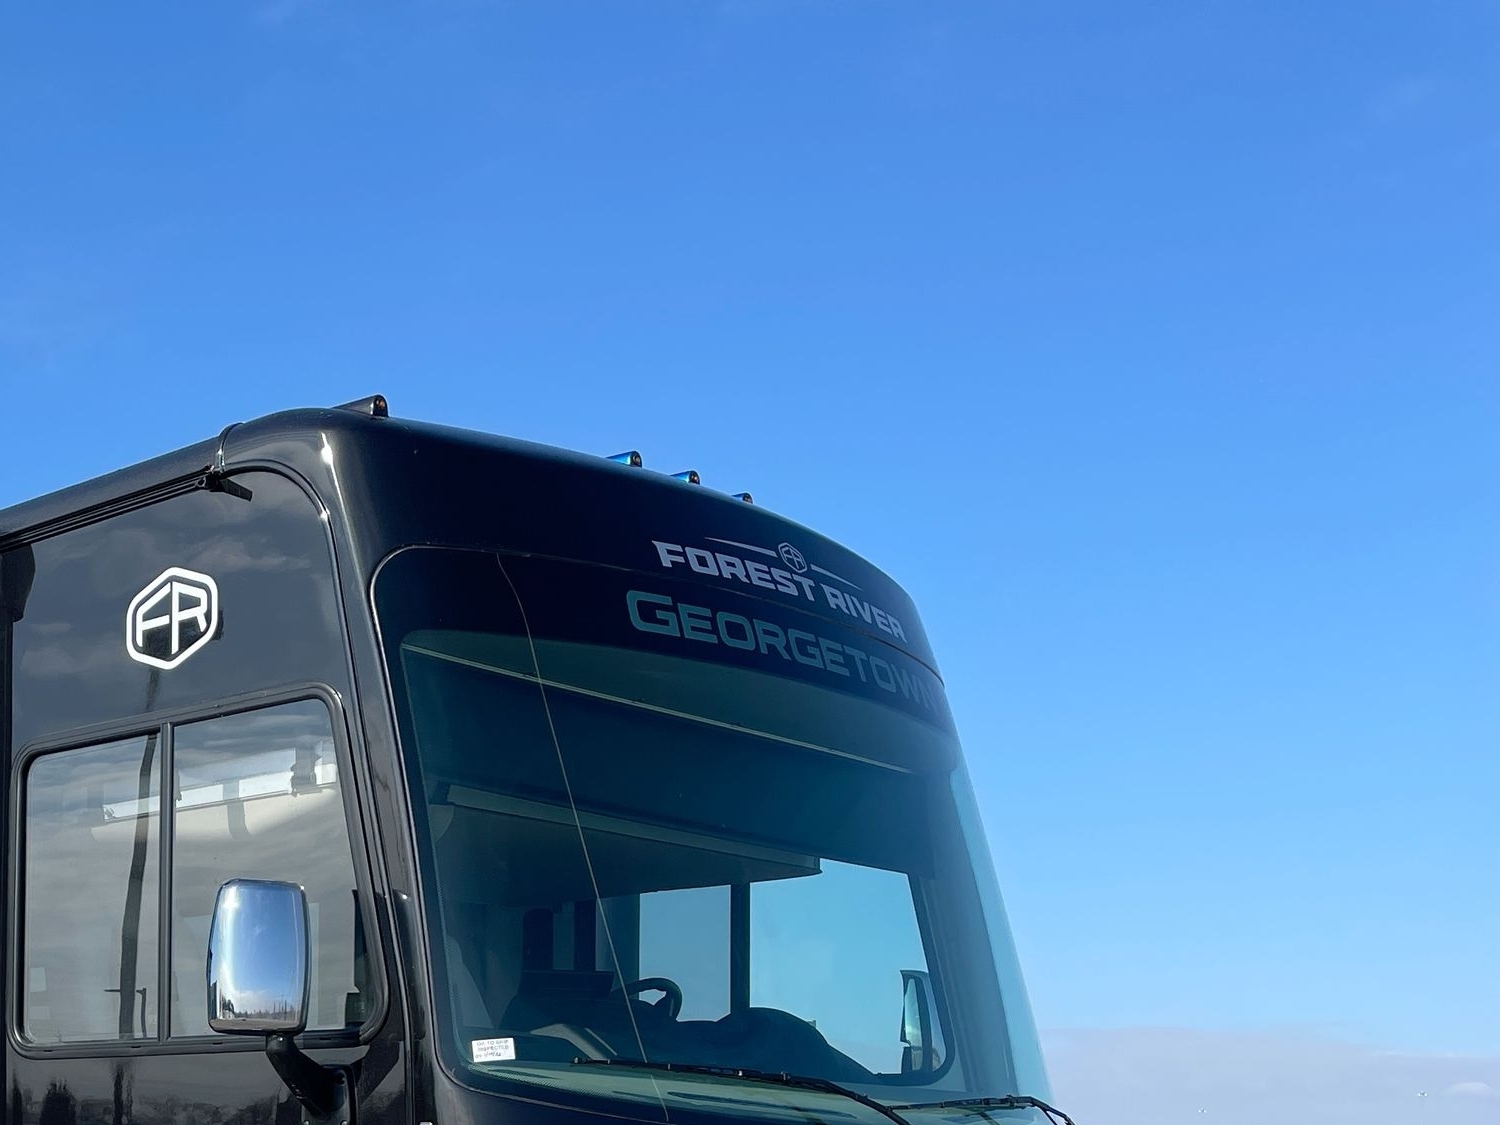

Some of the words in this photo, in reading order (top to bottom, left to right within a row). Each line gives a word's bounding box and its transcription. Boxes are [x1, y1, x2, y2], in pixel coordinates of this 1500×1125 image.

[652, 540, 816, 602] FOREST
[820, 582, 907, 643] RIVER
[626, 589, 940, 714] GEORGETOWN
